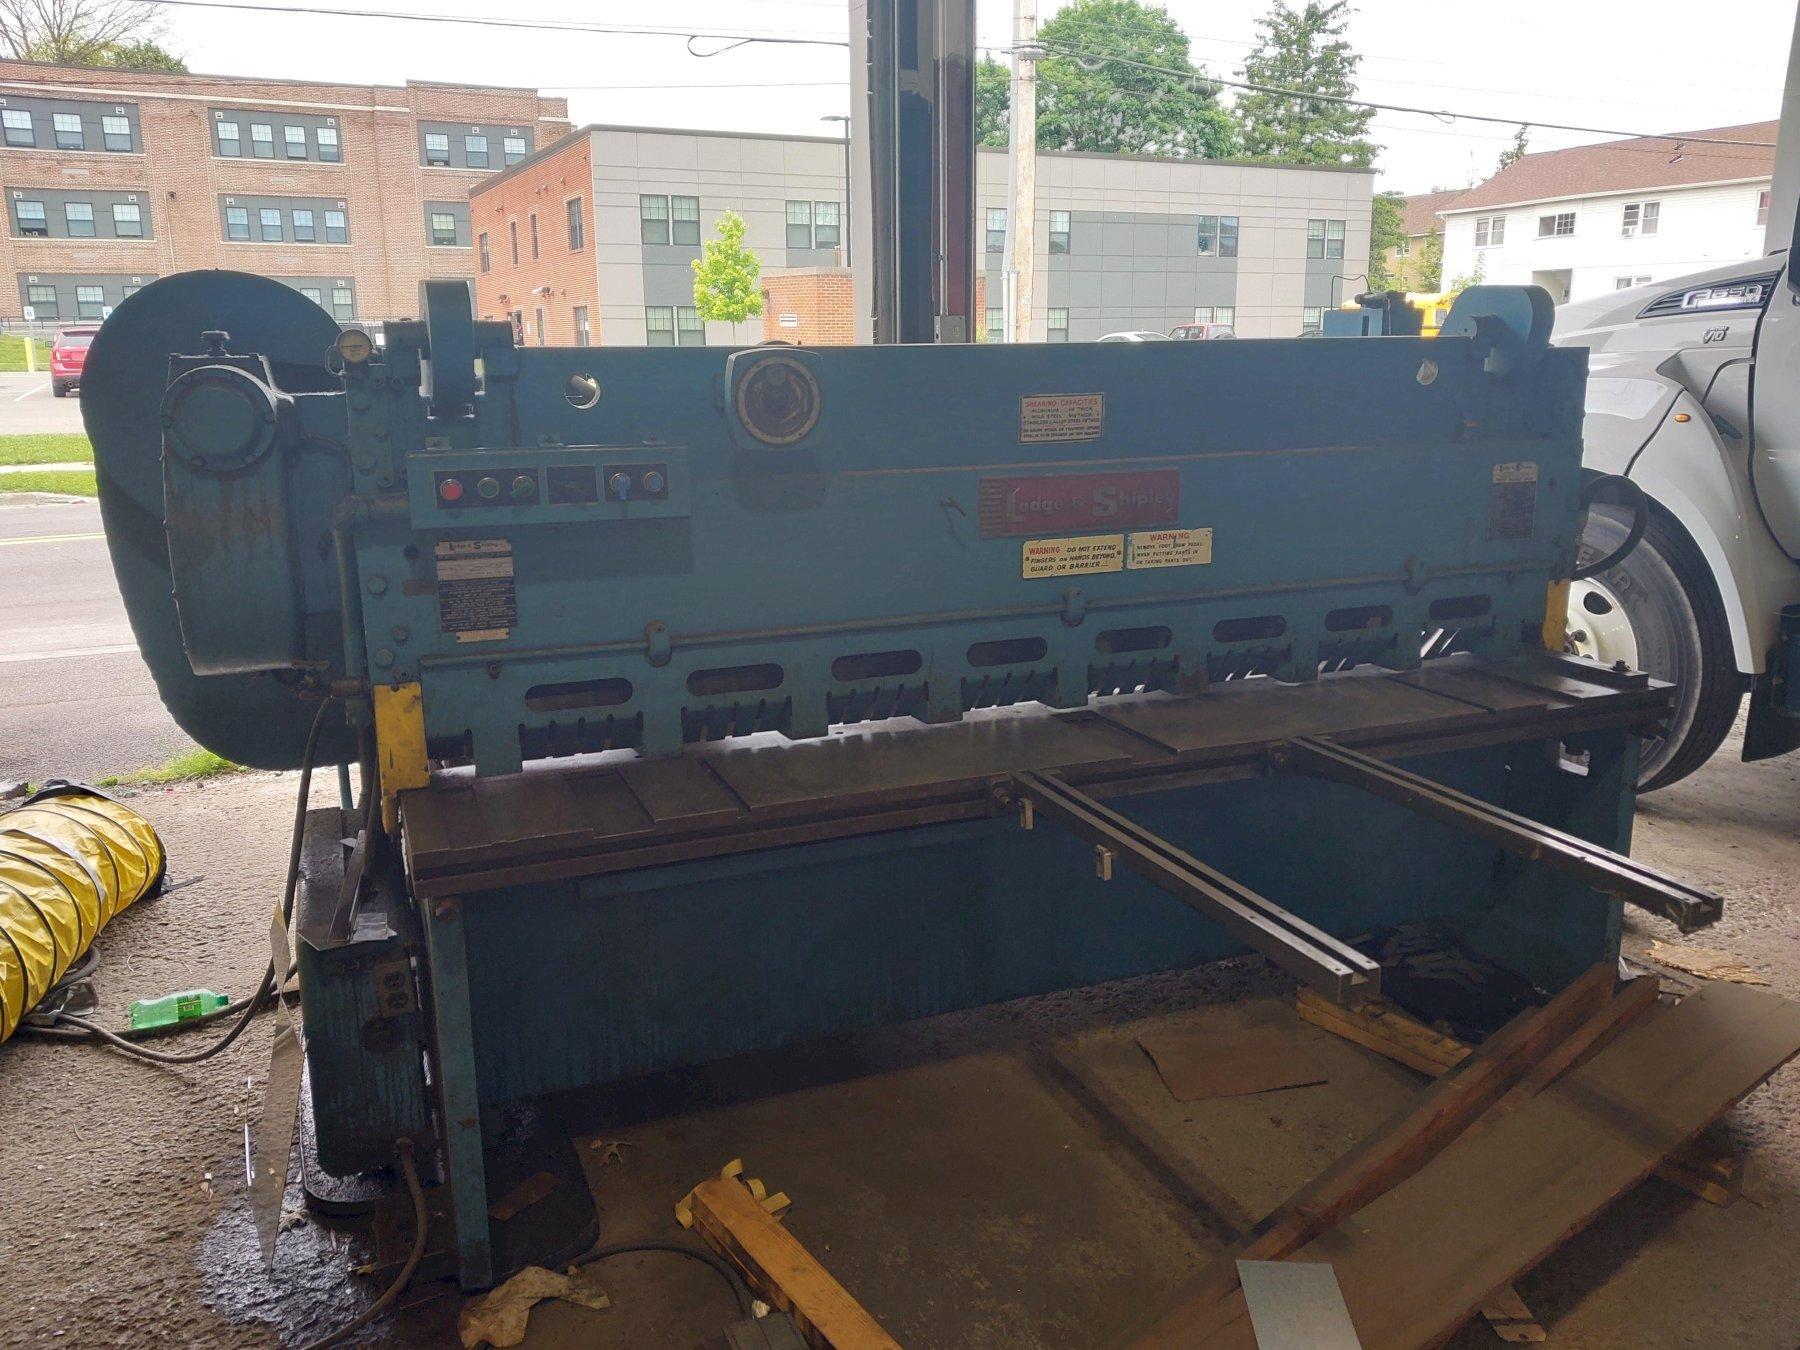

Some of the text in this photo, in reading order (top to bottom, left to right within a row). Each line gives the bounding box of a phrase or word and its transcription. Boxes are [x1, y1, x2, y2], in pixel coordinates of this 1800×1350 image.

[1061, 398, 1098, 407] CAPACITIES
[1150, 532, 1190, 541] WARNING
[1029, 546, 1060, 555] WARNING
[1092, 544, 1117, 552] EXTEND
